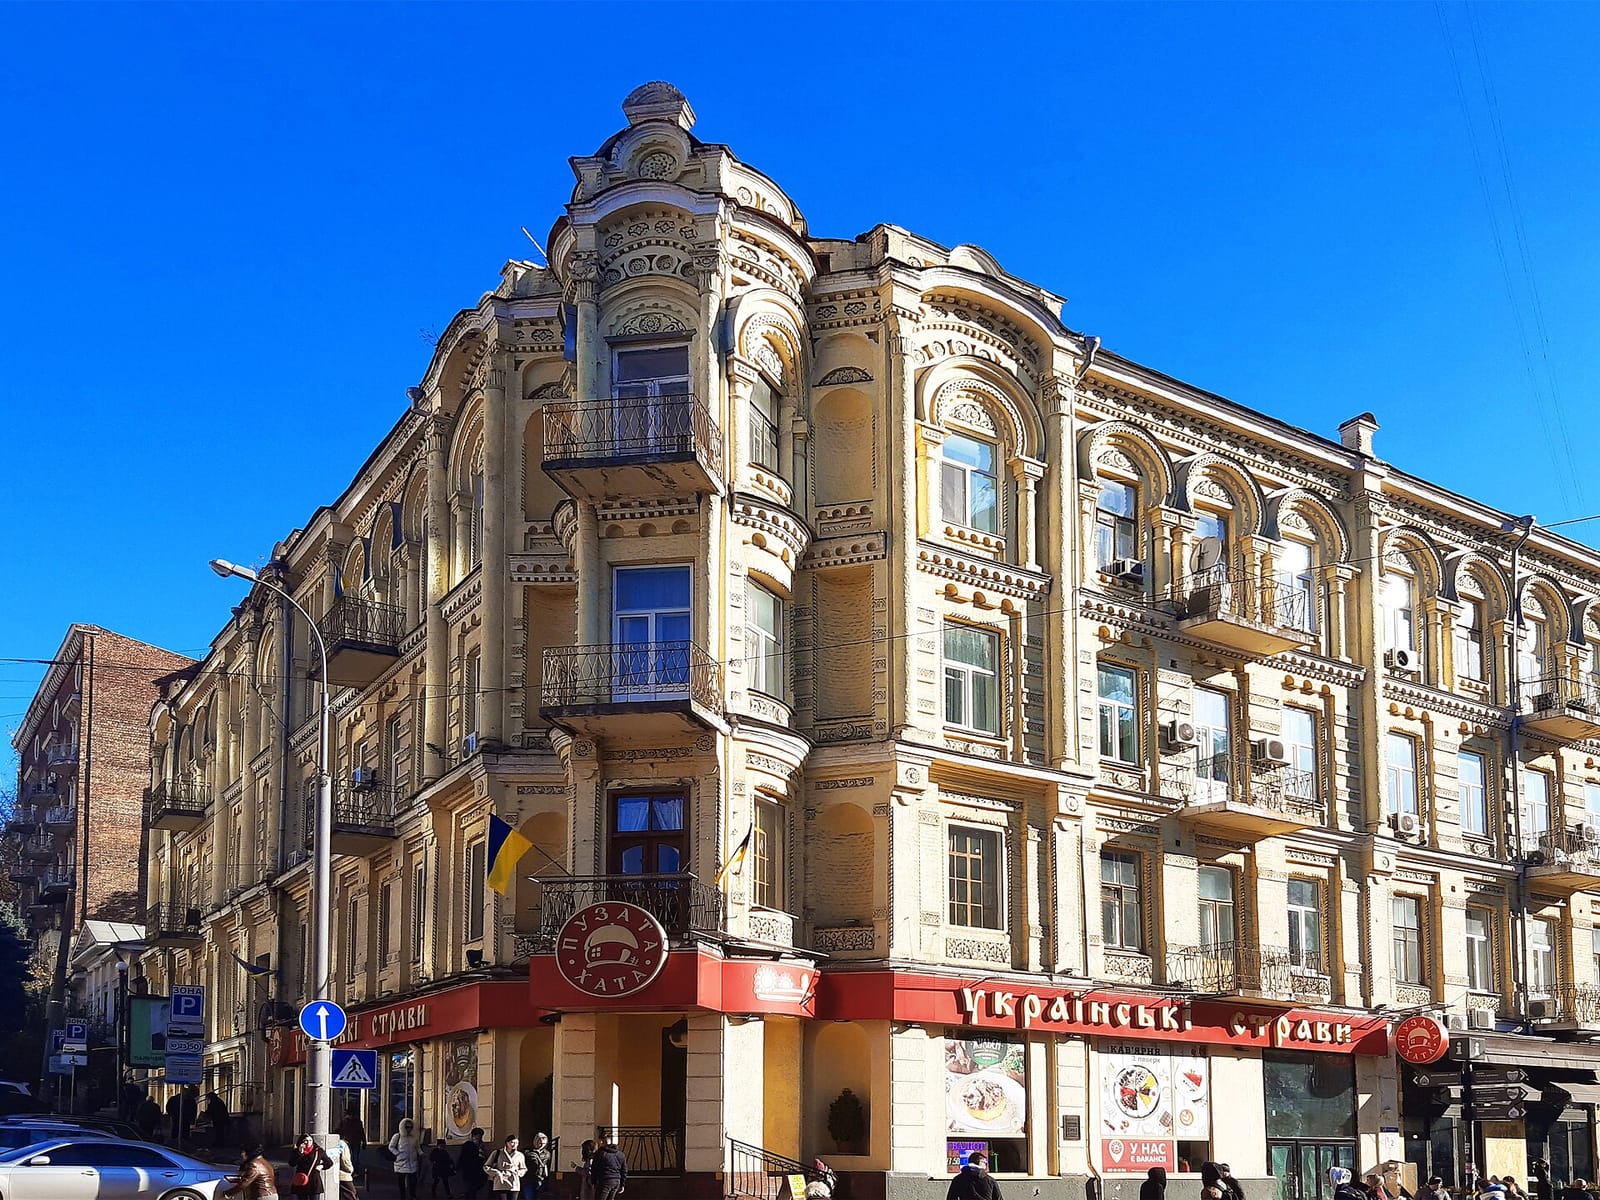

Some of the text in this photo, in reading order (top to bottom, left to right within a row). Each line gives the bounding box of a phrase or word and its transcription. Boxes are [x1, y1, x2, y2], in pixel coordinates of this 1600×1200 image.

[561, 906, 659, 953] ПУЗАТА
[573, 968, 648, 992] ХАТА
[173, 986, 203, 995] ЗОНА
[371, 1002, 426, 1042] страви
[1398, 1018, 1440, 1041] ПУЗАТА
[1110, 1045, 1161, 1056] КАВ'ЯРНЯ
[1403, 1048, 1436, 1060] ХАТА
[1129, 1142, 1138, 1155] У
[1141, 1142, 1167, 1155] НАС
